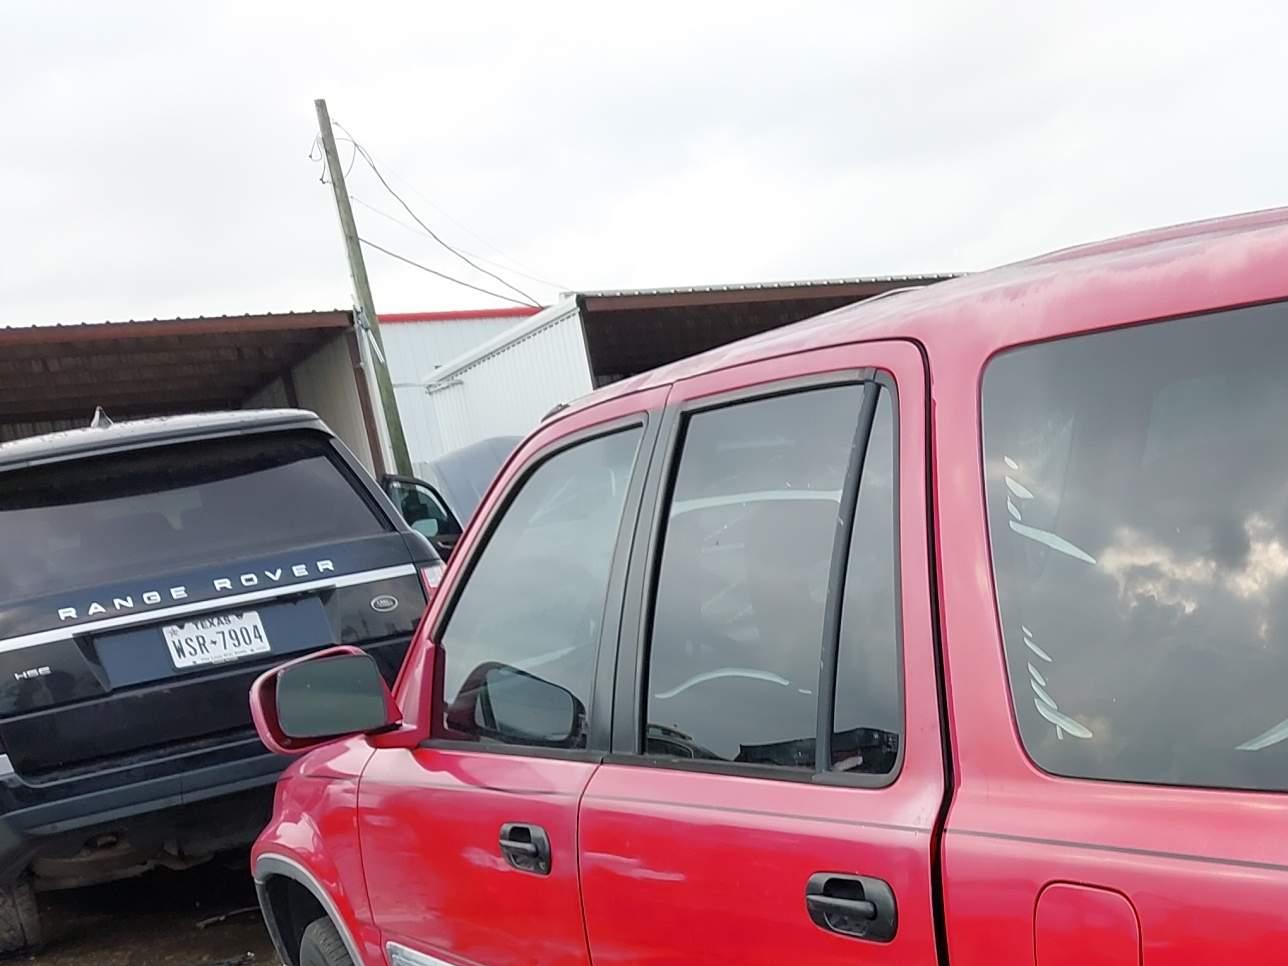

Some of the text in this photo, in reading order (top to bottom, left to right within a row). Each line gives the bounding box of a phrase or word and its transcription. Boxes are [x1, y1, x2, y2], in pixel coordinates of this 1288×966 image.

[58, 559, 335, 621] RANGE ROVER
[14, 666, 51, 680] HSE
